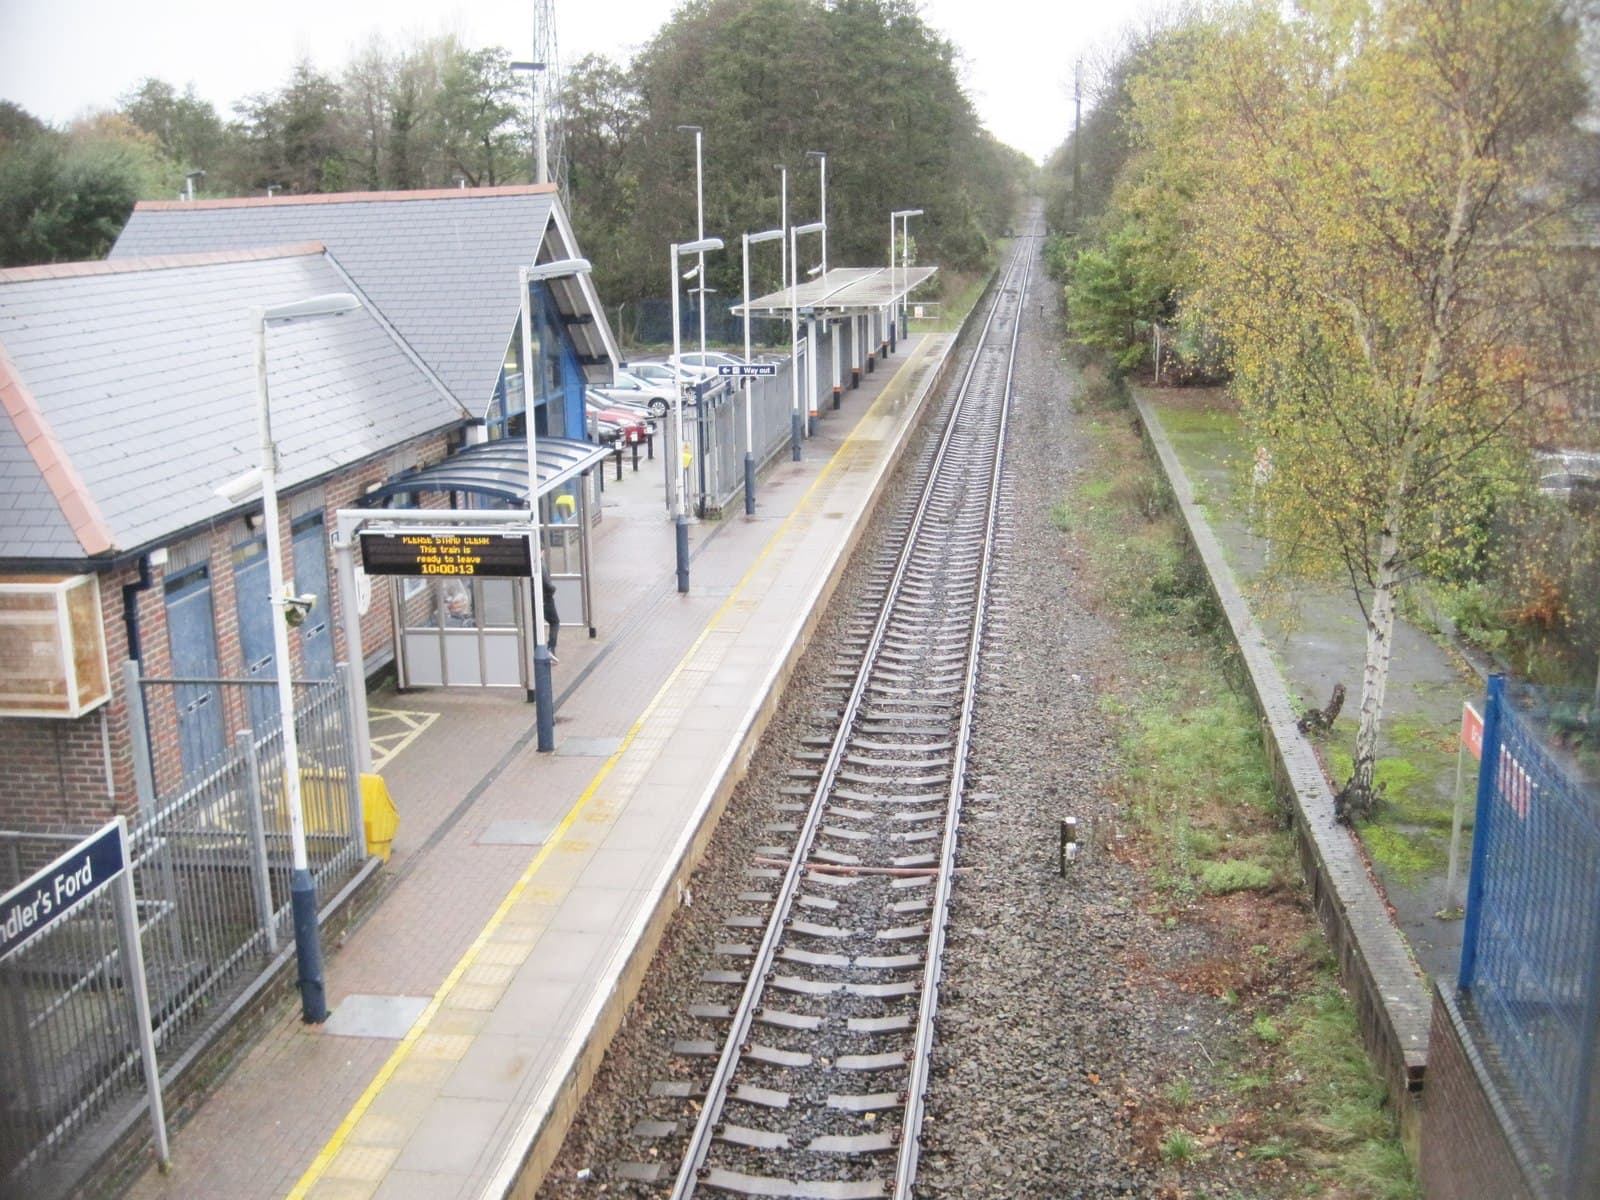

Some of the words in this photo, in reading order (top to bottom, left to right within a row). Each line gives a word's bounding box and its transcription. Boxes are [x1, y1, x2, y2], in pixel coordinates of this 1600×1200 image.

[744, 367, 758, 376] Way
[420, 545, 437, 554] This
[440, 545, 460, 554] train
[463, 545, 471, 554] is
[416, 554, 441, 564] ready
[444, 555, 454, 563] to
[457, 555, 480, 564] leave
[421, 564, 474, 574] 10:00:13
[54, 855, 93, 905] Ford
